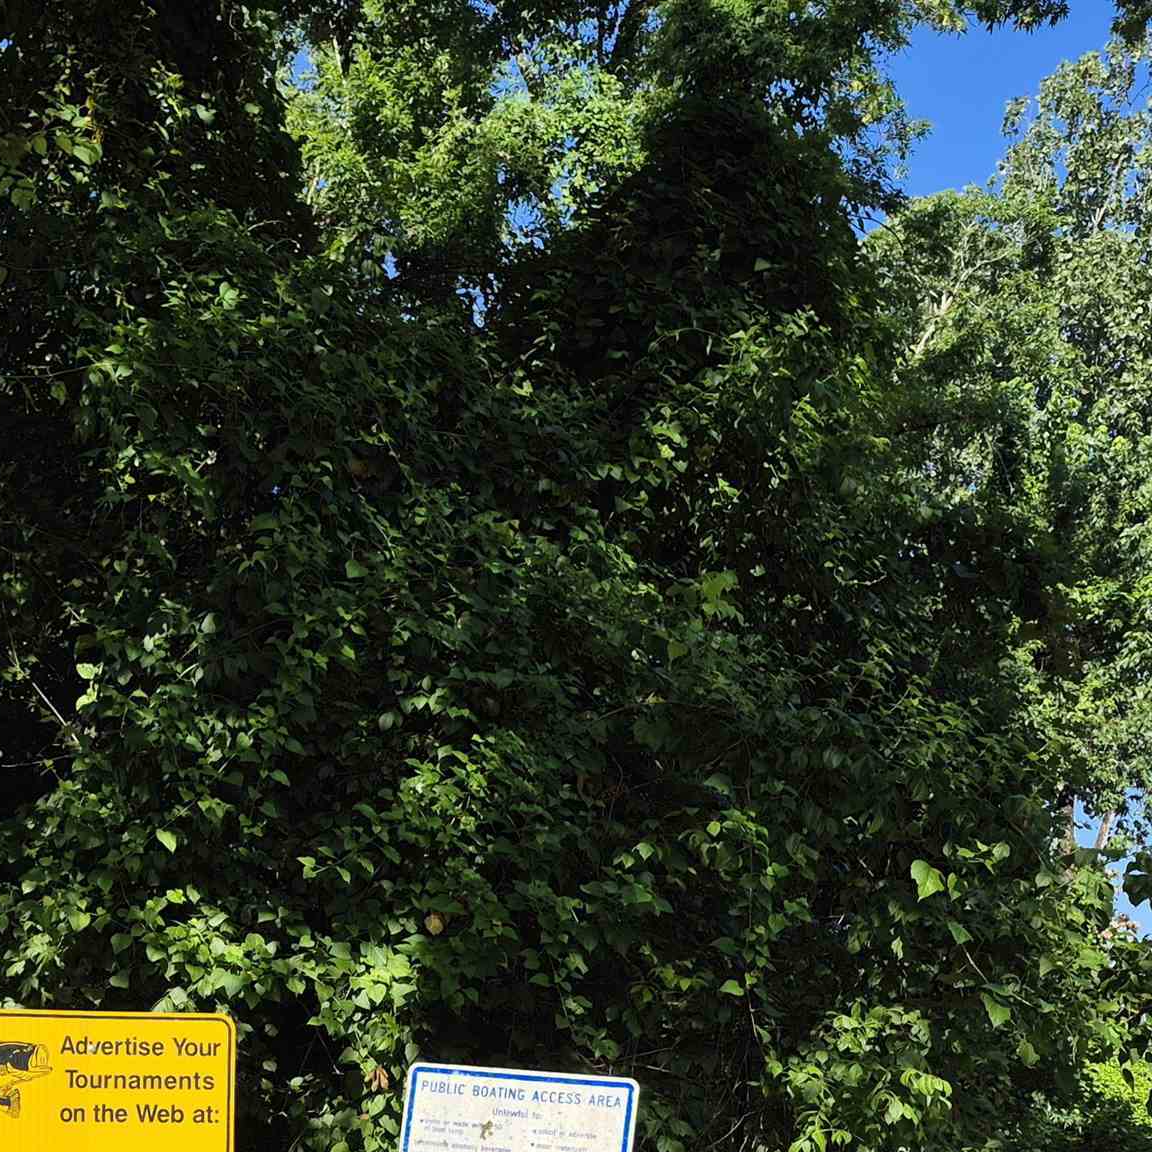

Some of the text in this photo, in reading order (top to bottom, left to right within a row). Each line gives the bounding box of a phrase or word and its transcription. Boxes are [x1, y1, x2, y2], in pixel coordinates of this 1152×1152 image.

[60, 1036, 221, 1057] Advertise Your
[65, 1070, 215, 1091] Tournaments
[421, 1080, 622, 1108] PUBLIC BOATING ACCESS AREA
[60, 1104, 220, 1123] on the Web at:
